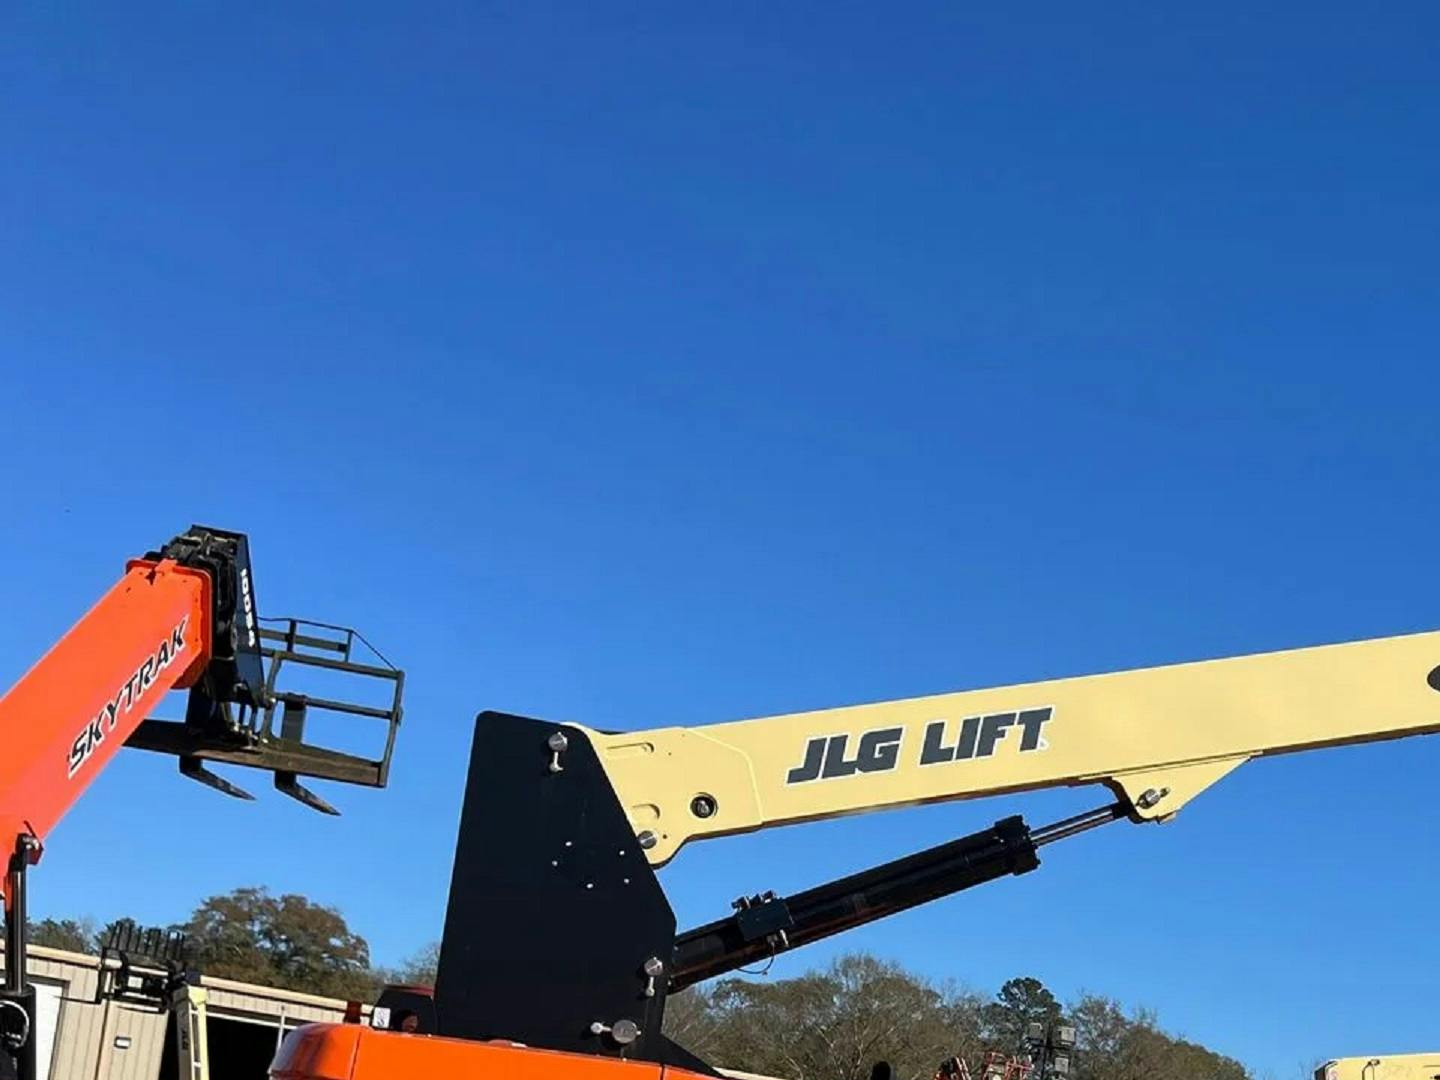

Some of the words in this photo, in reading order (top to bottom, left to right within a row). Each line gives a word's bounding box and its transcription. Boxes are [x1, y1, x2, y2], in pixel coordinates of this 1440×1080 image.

[67, 614, 190, 779] SKYTRAK
[785, 725, 904, 785] JLG
[919, 706, 1056, 767] LIFT
